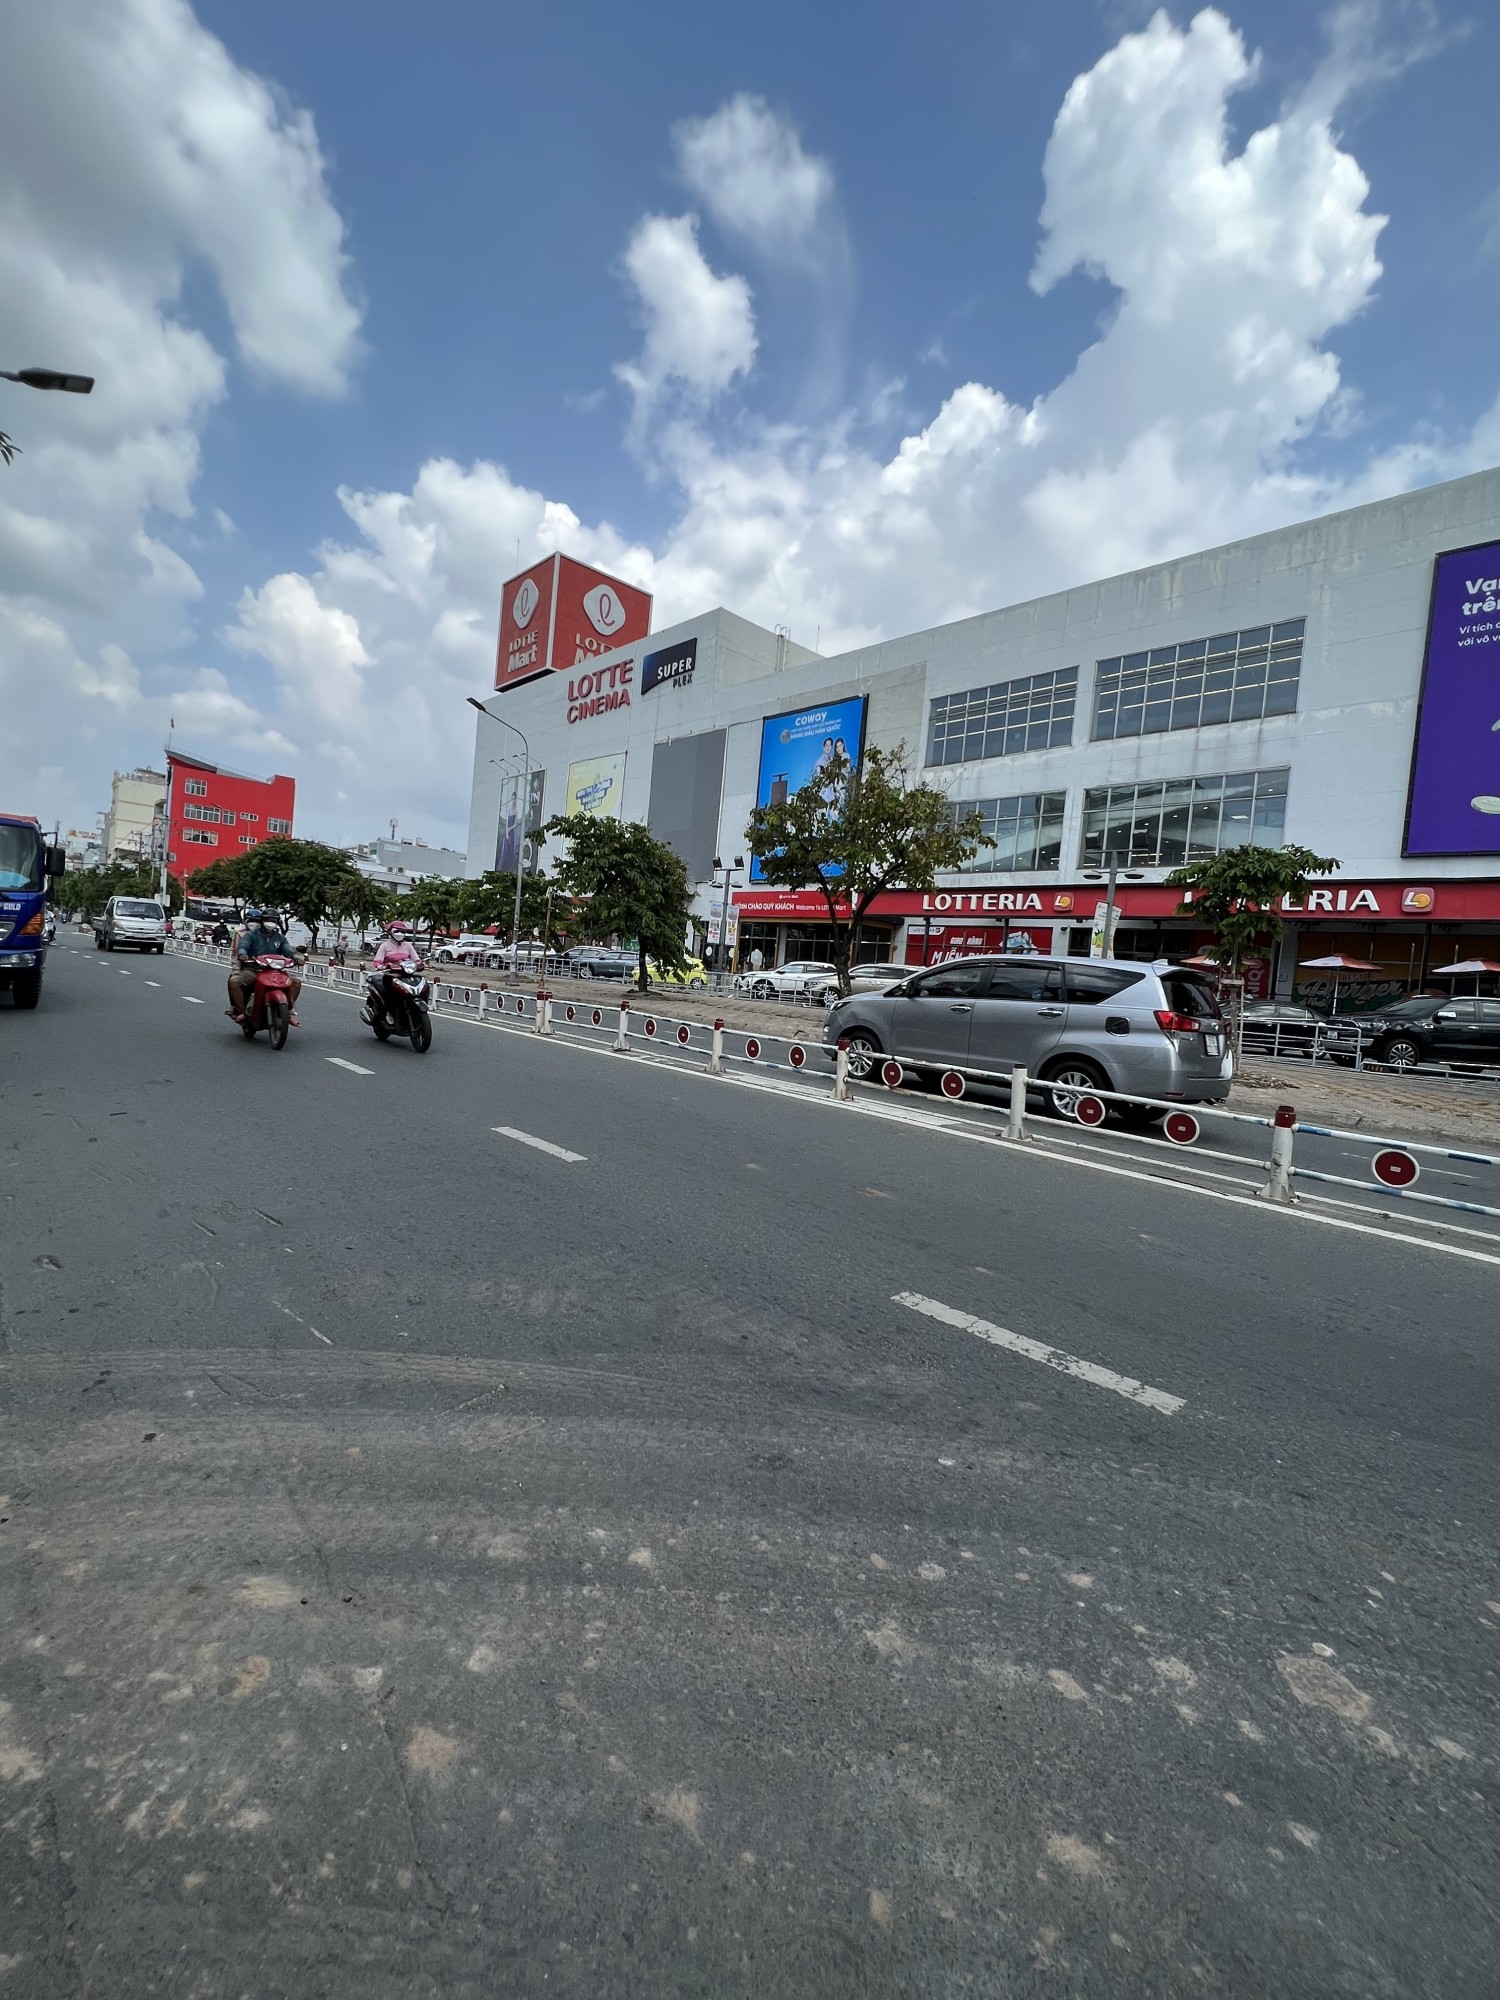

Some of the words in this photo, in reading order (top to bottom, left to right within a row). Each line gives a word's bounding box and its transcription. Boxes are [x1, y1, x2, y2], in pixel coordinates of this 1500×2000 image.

[1465, 578, 1500, 596] Vạ
[1462, 596, 1500, 615] trê
[1459, 625, 1471, 634] Ví
[1472, 622, 1493, 632] tích
[508, 629, 539, 653] LOTTE
[575, 633, 614, 654] LOT
[507, 644, 538, 673] Mart
[657, 657, 693, 680] SUPER
[568, 658, 634, 701] LOTTE
[672, 673, 693, 688] PLEX
[566, 688, 630, 724] CINEMA
[3, 902, 21, 911] GOLD
[747, 901, 763, 910] CHÀO
[762, 902, 774, 910] QUÝ
[774, 901, 794, 910] KHÁCH
[923, 893, 1043, 911] LOTTERIA
[1341, 974, 1364, 982] BEST
[1297, 978, 1404, 1008] Burger
